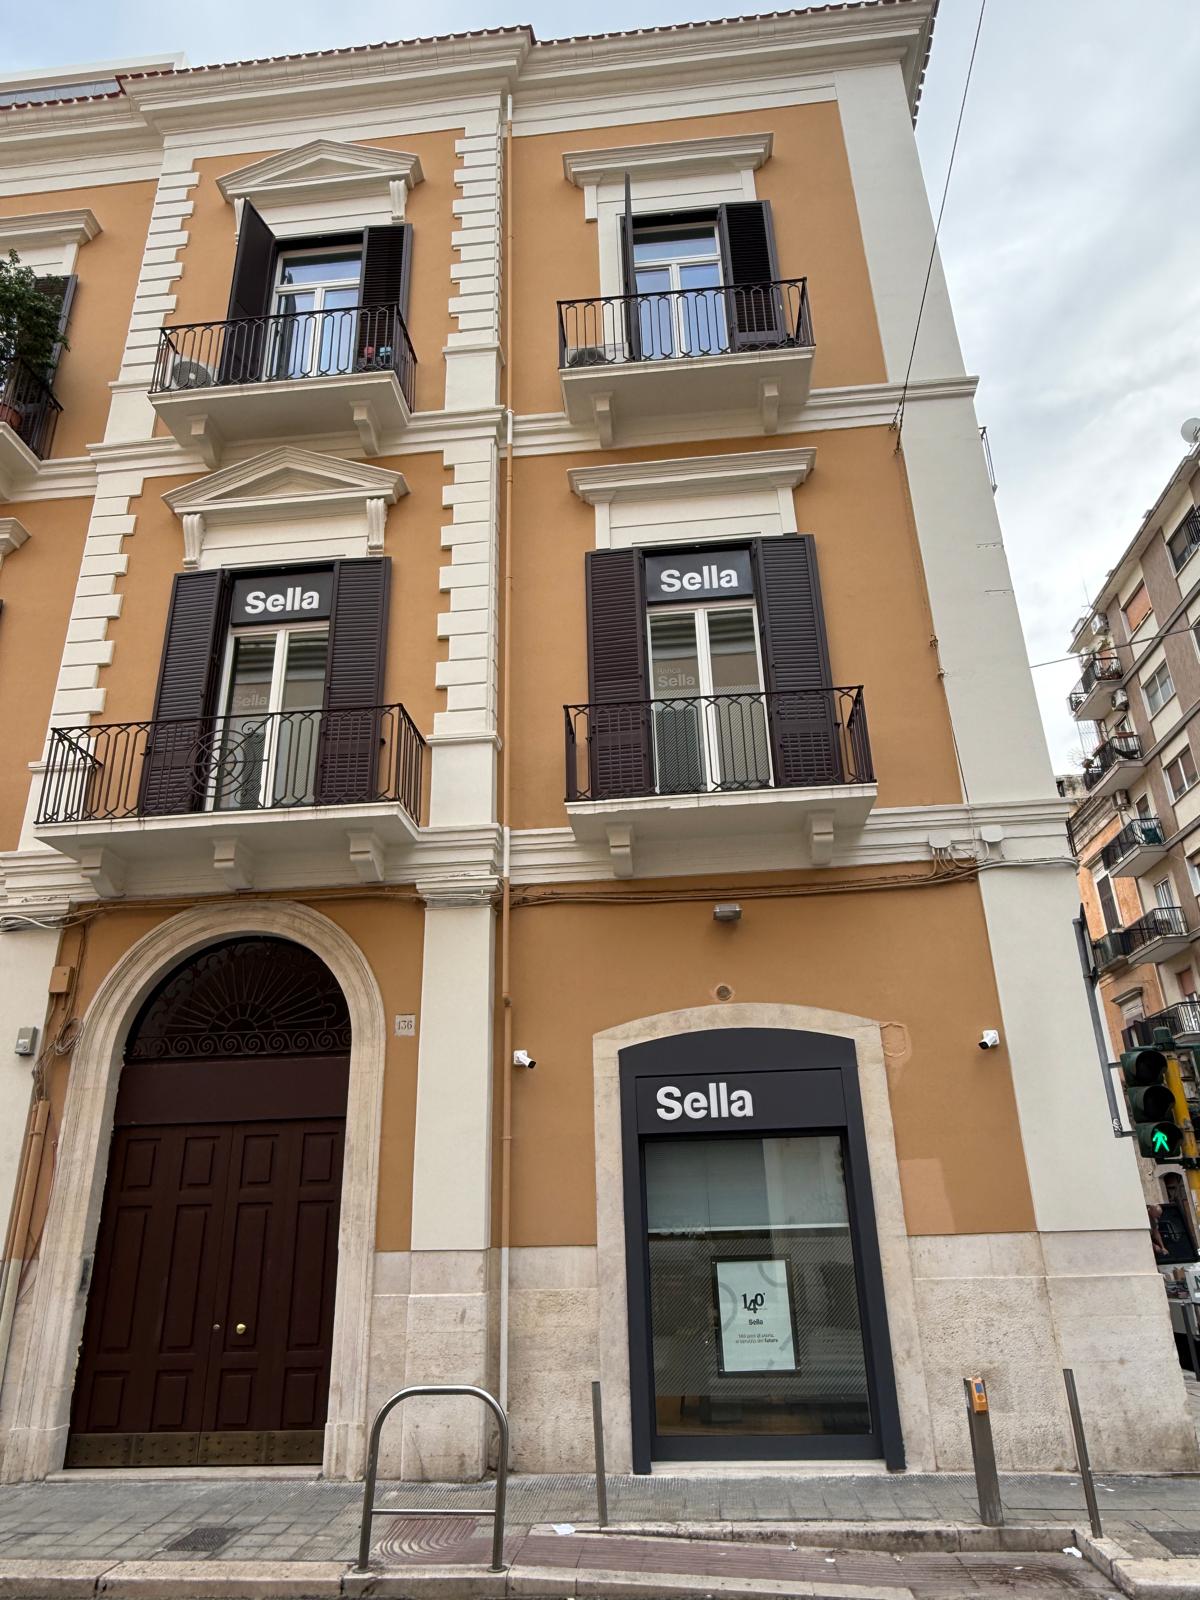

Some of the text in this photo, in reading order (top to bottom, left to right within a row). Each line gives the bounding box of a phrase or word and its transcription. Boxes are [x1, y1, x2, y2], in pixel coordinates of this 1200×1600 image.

[660, 565, 738, 592] Sella
[245, 587, 320, 614] Sella
[658, 674, 696, 687] Sella
[398, 1020, 412, 1030] 136
[656, 1082, 754, 1121] Sella
[748, 1318, 764, 1326] Sella
